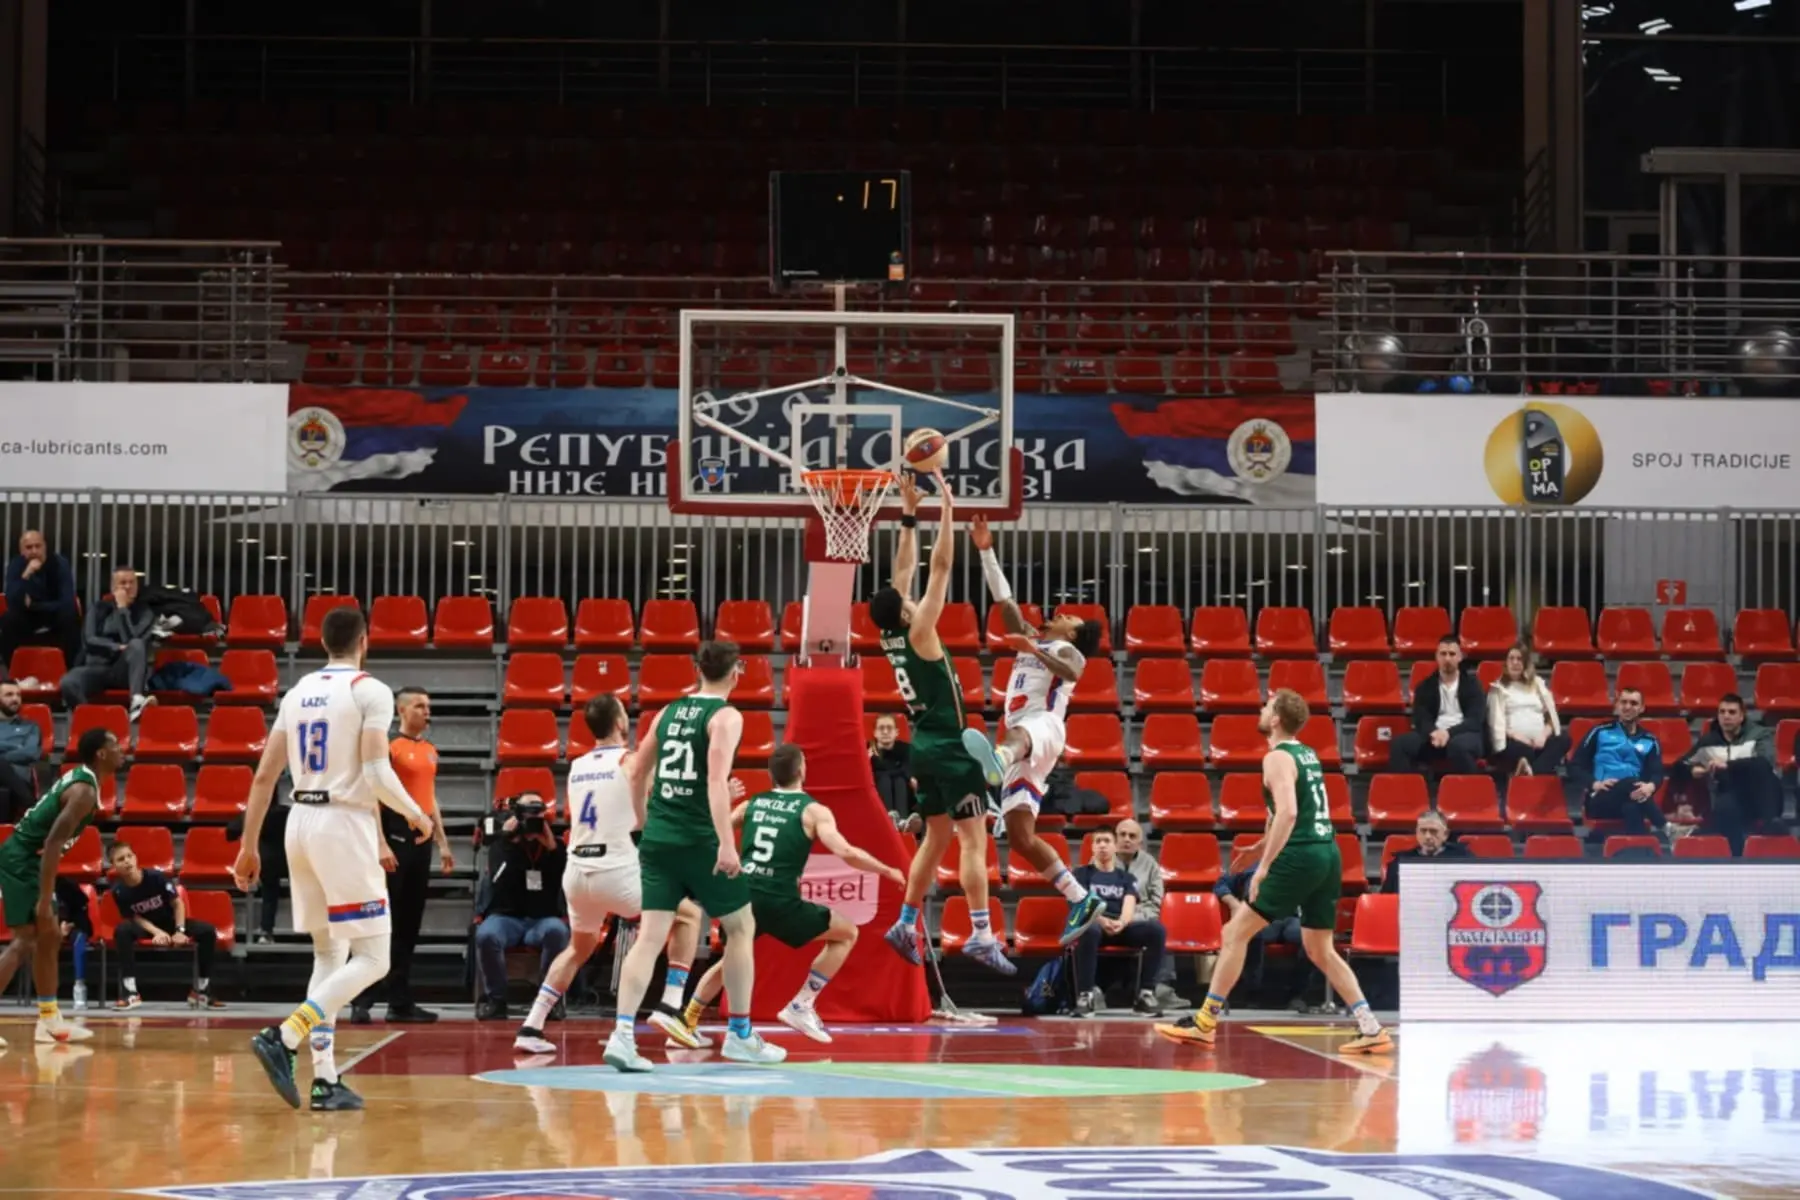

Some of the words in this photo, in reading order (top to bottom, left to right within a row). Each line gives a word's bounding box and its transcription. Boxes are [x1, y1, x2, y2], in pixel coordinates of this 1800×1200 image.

[864, 179, 897, 210] 17
[1632, 452, 1682, 468] SPOJ
[1690, 453, 1791, 469] TRADICIJE
[297, 720, 329, 774] 13
[658, 740, 698, 780] 21
[579, 790, 598, 831] 4
[751, 826, 779, 863] 5
[1590, 912, 1800, 982] ГРАД
